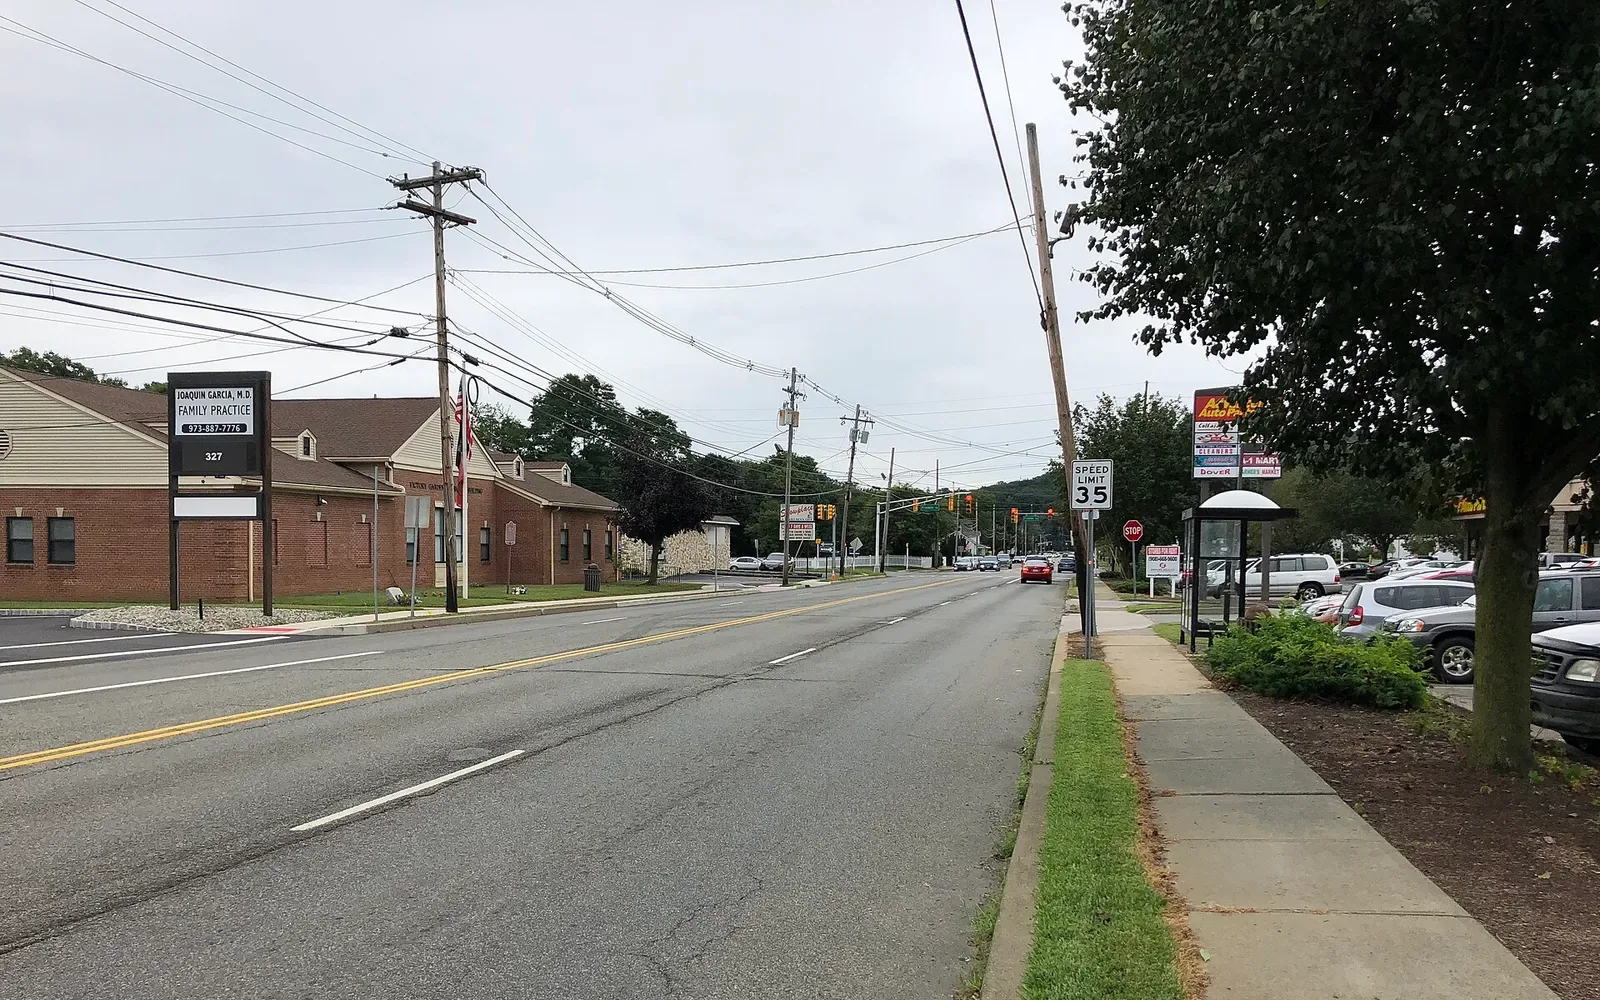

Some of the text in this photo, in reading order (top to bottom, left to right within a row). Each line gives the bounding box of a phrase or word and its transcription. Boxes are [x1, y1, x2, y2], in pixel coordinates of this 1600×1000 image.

[177, 390, 252, 401] JOAQUIN GARCIA, M.D.
[178, 404, 251, 416] FAMILY PRACTICE
[1198, 408, 1226, 418] Auto
[188, 424, 241, 433] 973-887-7776
[205, 452, 223, 461] 327
[1075, 466, 1109, 474] SPEED
[1078, 476, 1105, 484] LIMIT
[1075, 486, 1108, 504] 35
[780, 505, 813, 517] Sowplace
[1124, 527, 1141, 535] STOP
